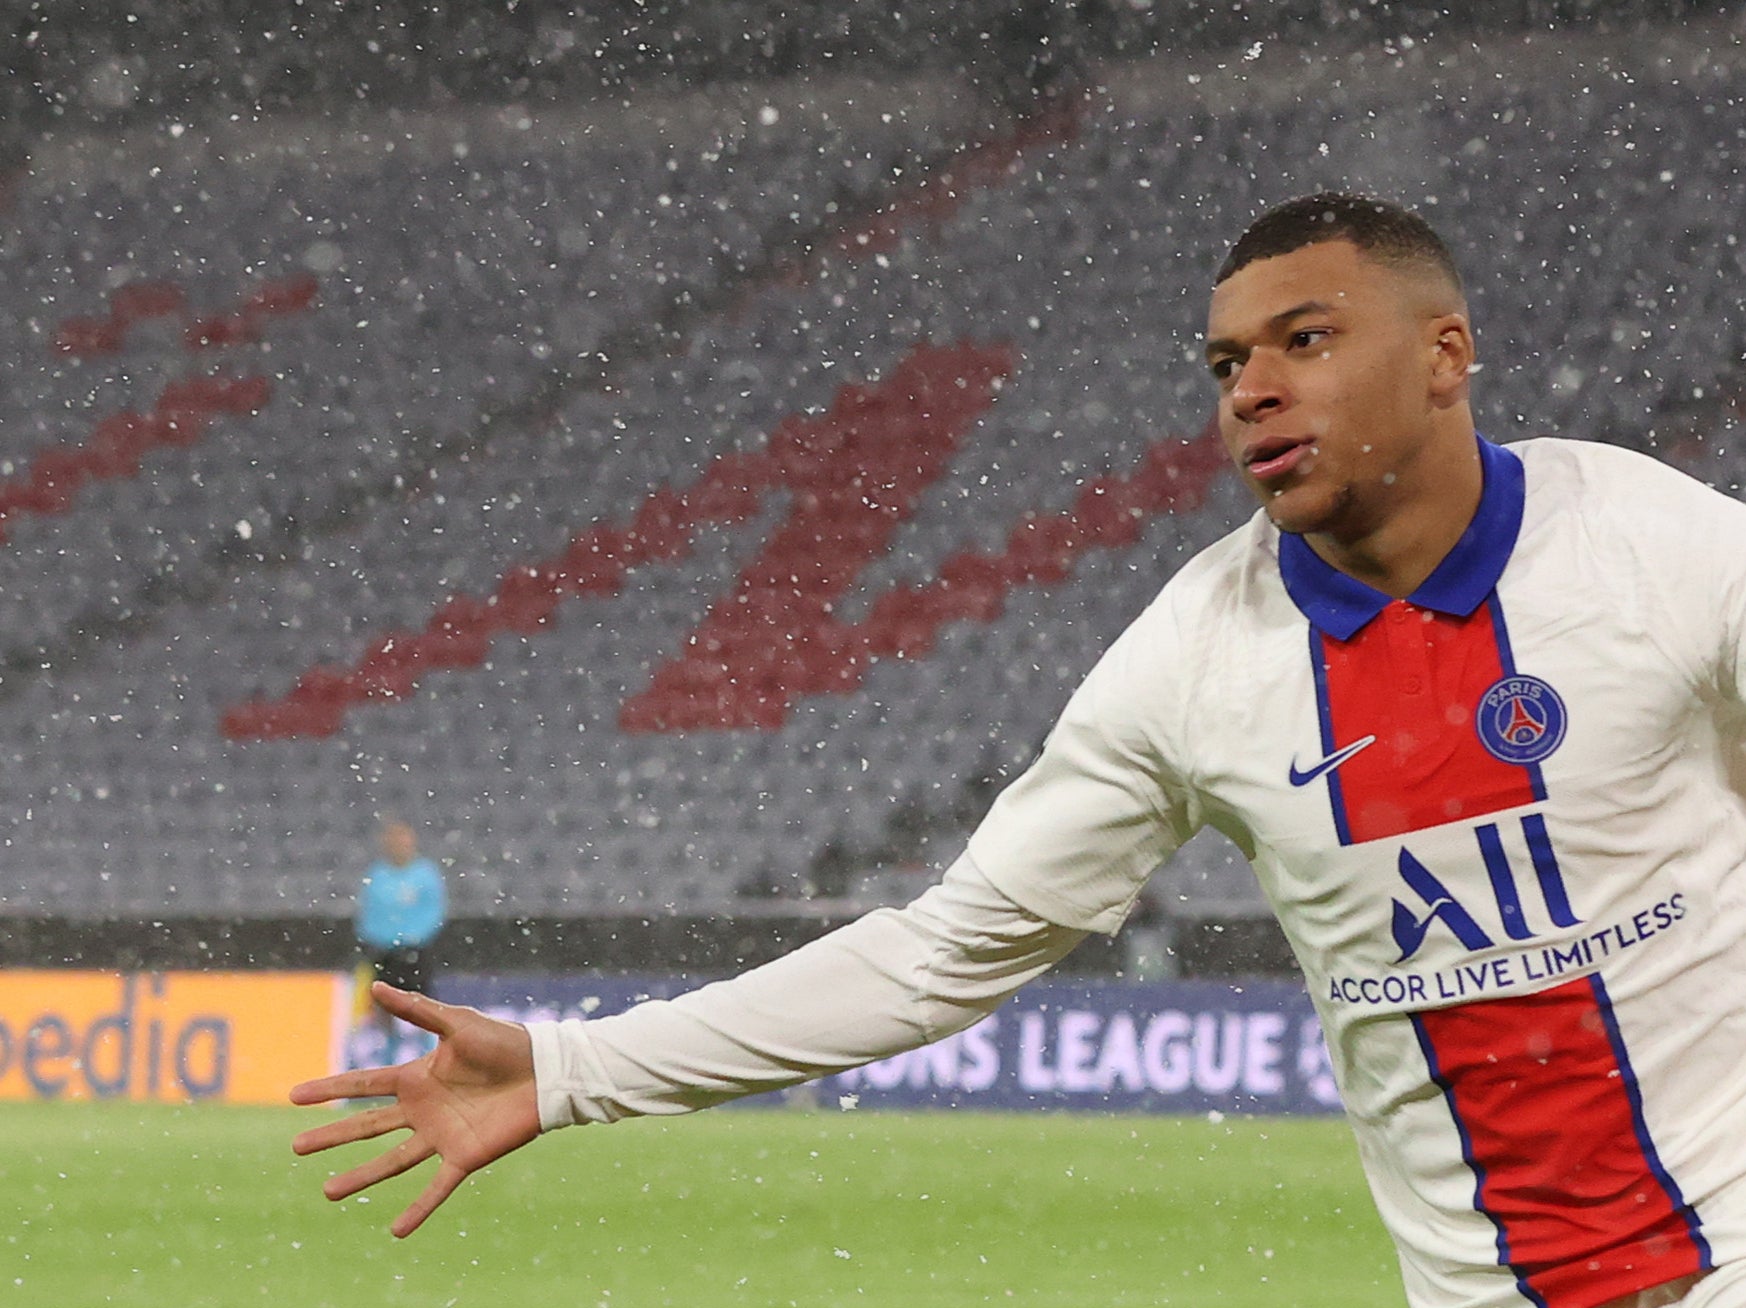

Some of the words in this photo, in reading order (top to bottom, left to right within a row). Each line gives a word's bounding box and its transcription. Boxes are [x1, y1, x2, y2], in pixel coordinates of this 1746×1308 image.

[1487, 681, 1543, 708] PARIS
[1329, 975, 1427, 1004] ACCOR
[1435, 958, 1515, 999] LIVE
[1521, 892, 1688, 982] LIMITLESS
[0, 972, 231, 1098] edia
[1017, 1009, 1285, 1094] LEAGUE
